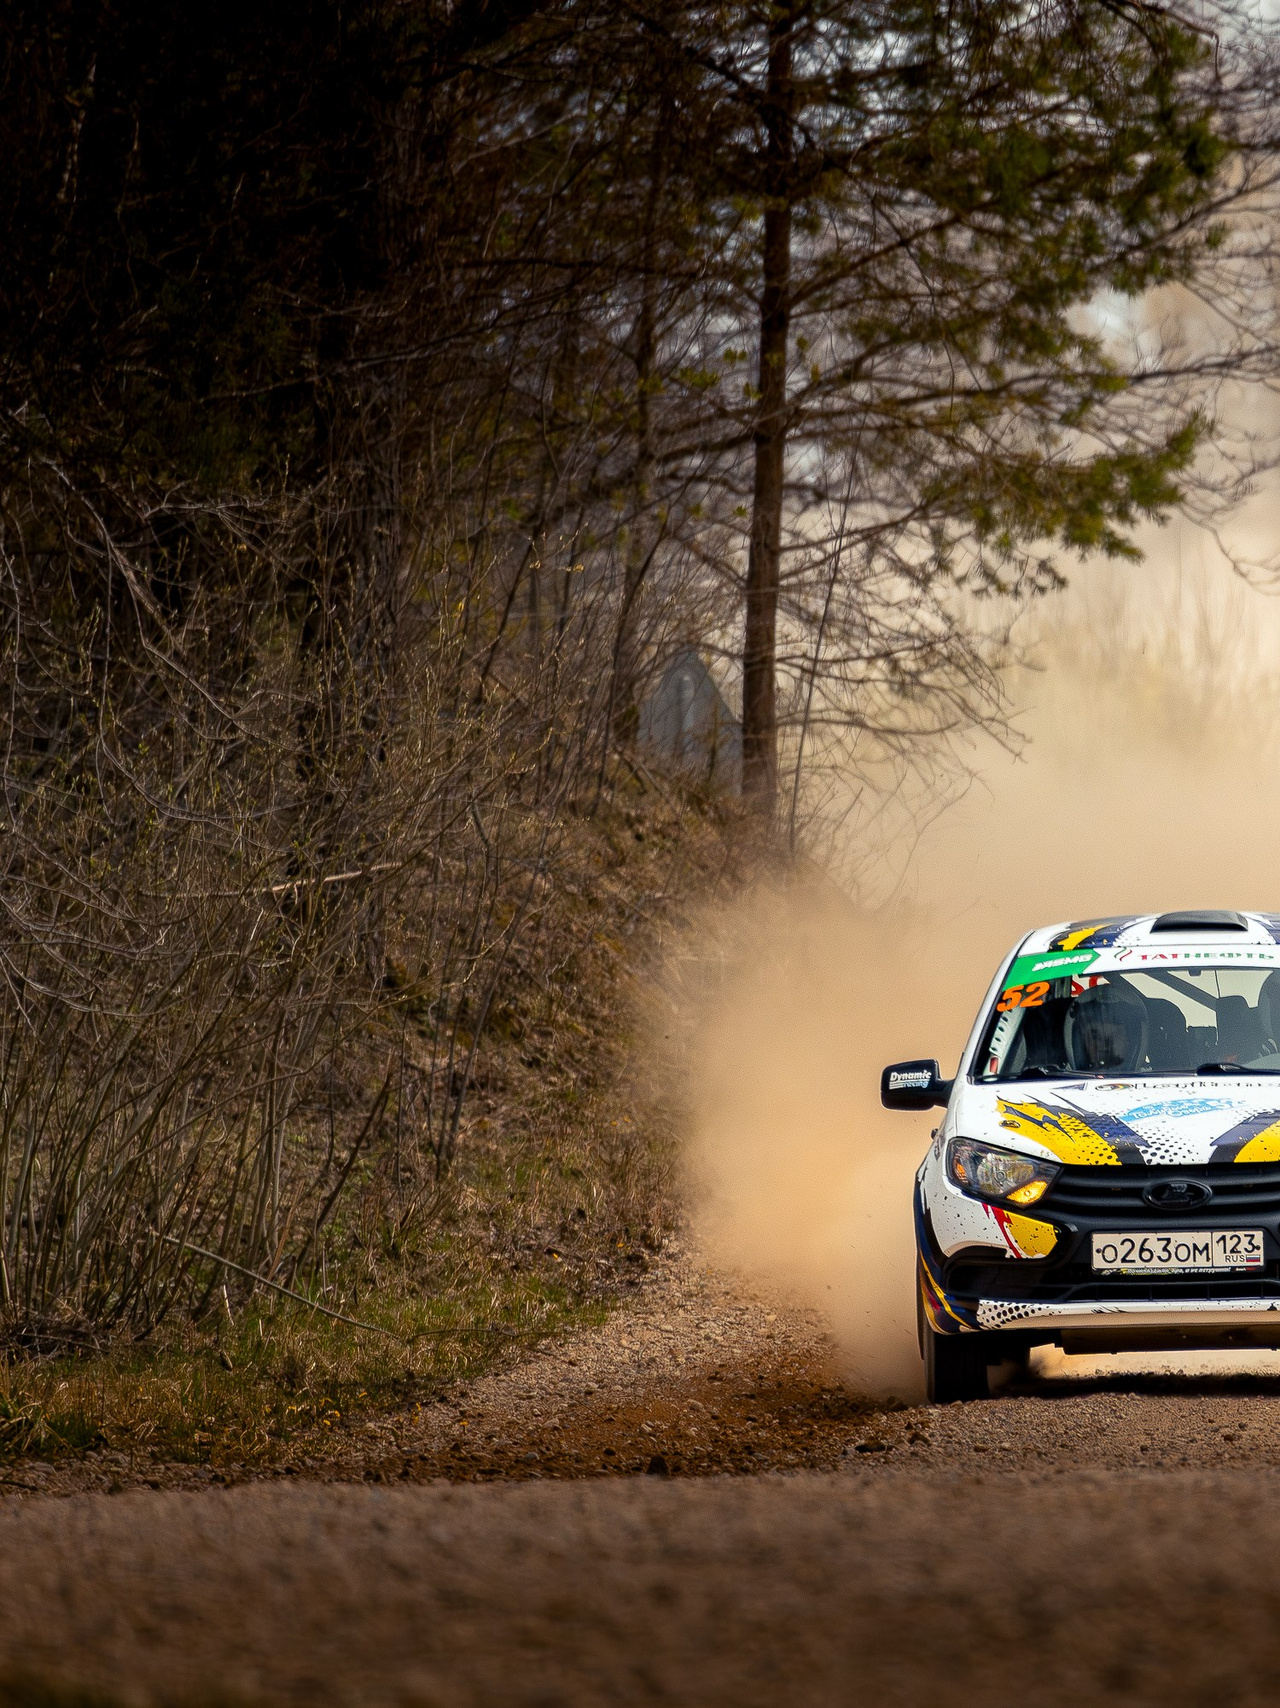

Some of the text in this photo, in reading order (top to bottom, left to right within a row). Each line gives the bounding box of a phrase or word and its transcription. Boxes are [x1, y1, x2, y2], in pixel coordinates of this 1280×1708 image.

[996, 981, 1051, 1012] 52
[890, 1069, 932, 1081] Dynamic
[1216, 1233, 1257, 1254] 123
[1225, 1254, 1246, 1263] RUS
